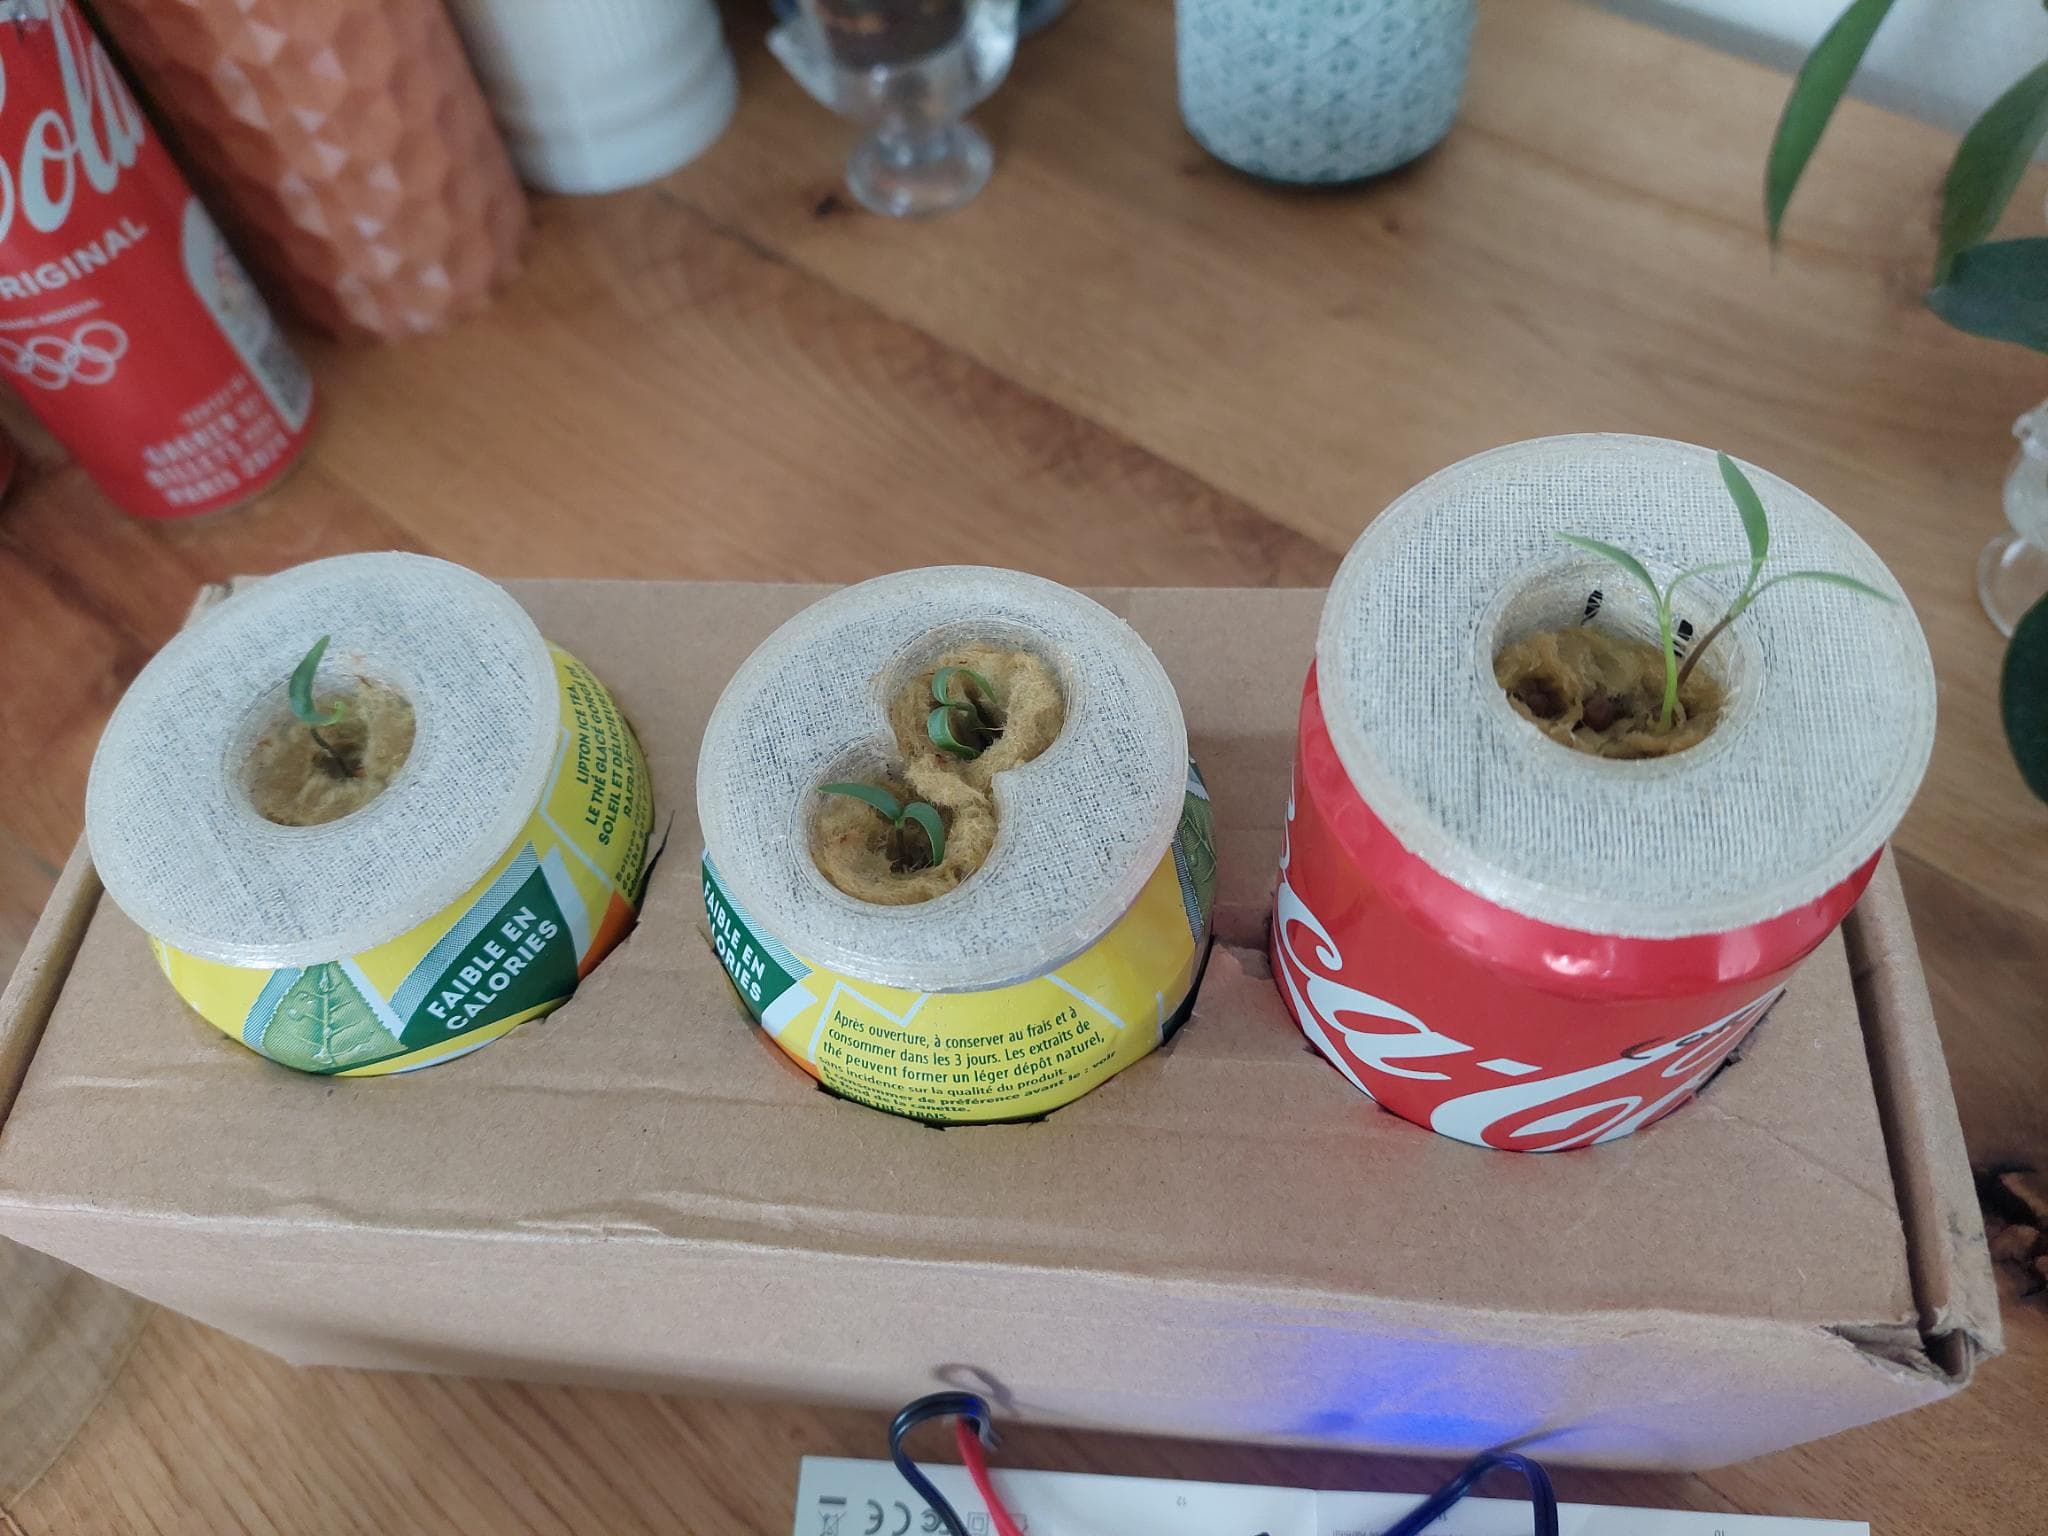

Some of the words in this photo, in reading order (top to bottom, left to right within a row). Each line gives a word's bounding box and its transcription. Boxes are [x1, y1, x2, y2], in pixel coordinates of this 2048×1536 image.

[0, 0, 145, 242] ola
[0, 216, 149, 300] RIGINAL
[575, 709, 589, 731] ICE
[576, 733, 591, 785] LIPTON
[591, 725, 607, 773] GLACÉ
[585, 805, 600, 825] LE
[591, 774, 606, 804] THÉ
[598, 792, 621, 846] SOLEIL
[612, 770, 623, 789] ET
[704, 879, 741, 950] FAIBLE
[741, 943, 766, 980] EN
[427, 939, 507, 1020] FAIBLE
[501, 905, 538, 942] EN
[446, 919, 558, 1030] CALORIES
[829, 1028, 896, 1059] consommer
[900, 1049, 929, 1064] dans
[933, 1053, 950, 1066] les
[955, 1053, 962, 1066] 3
[966, 1053, 1001, 1069] jours.
[1005, 1048, 1025, 1061] Les
[1030, 1029, 1073, 1055] extraits
[1076, 1019, 1090, 1035] de
[834, 1010, 864, 1033] Après
[869, 1025, 929, 1048] ouverture,
[934, 1034, 941, 1048] à
[945, 1034, 1004, 1049] conserver
[1008, 1031, 1024, 1043] au
[1027, 1020, 1053, 1038] frais
[1055, 1011, 1067, 1026] et
[1069, 1006, 1077, 1018] à
[823, 1041, 842, 1058] thé
[845, 1053, 897, 1076] peuvent
[902, 1066, 947, 1083] former
[952, 1073, 970, 1083] un
[975, 1068, 1009, 1084] léger
[1014, 1055, 1053, 1076] dépôt
[1056, 1031, 1105, 1063] naturel,
[847, 1067, 904, 1090] incidence
[908, 1086, 928, 1094] sur
[931, 1086, 943, 1095] la
[947, 1084, 993, 1097] qualité
[997, 1084, 1013, 1093] du
[1017, 1068, 1067, 1091] produit.
[940, 1094, 1020, 1106] préférence
[1024, 1079, 1065, 1097] avant
[1068, 1072, 1081, 1081] le
[1092, 1050, 1116, 1068] voir
